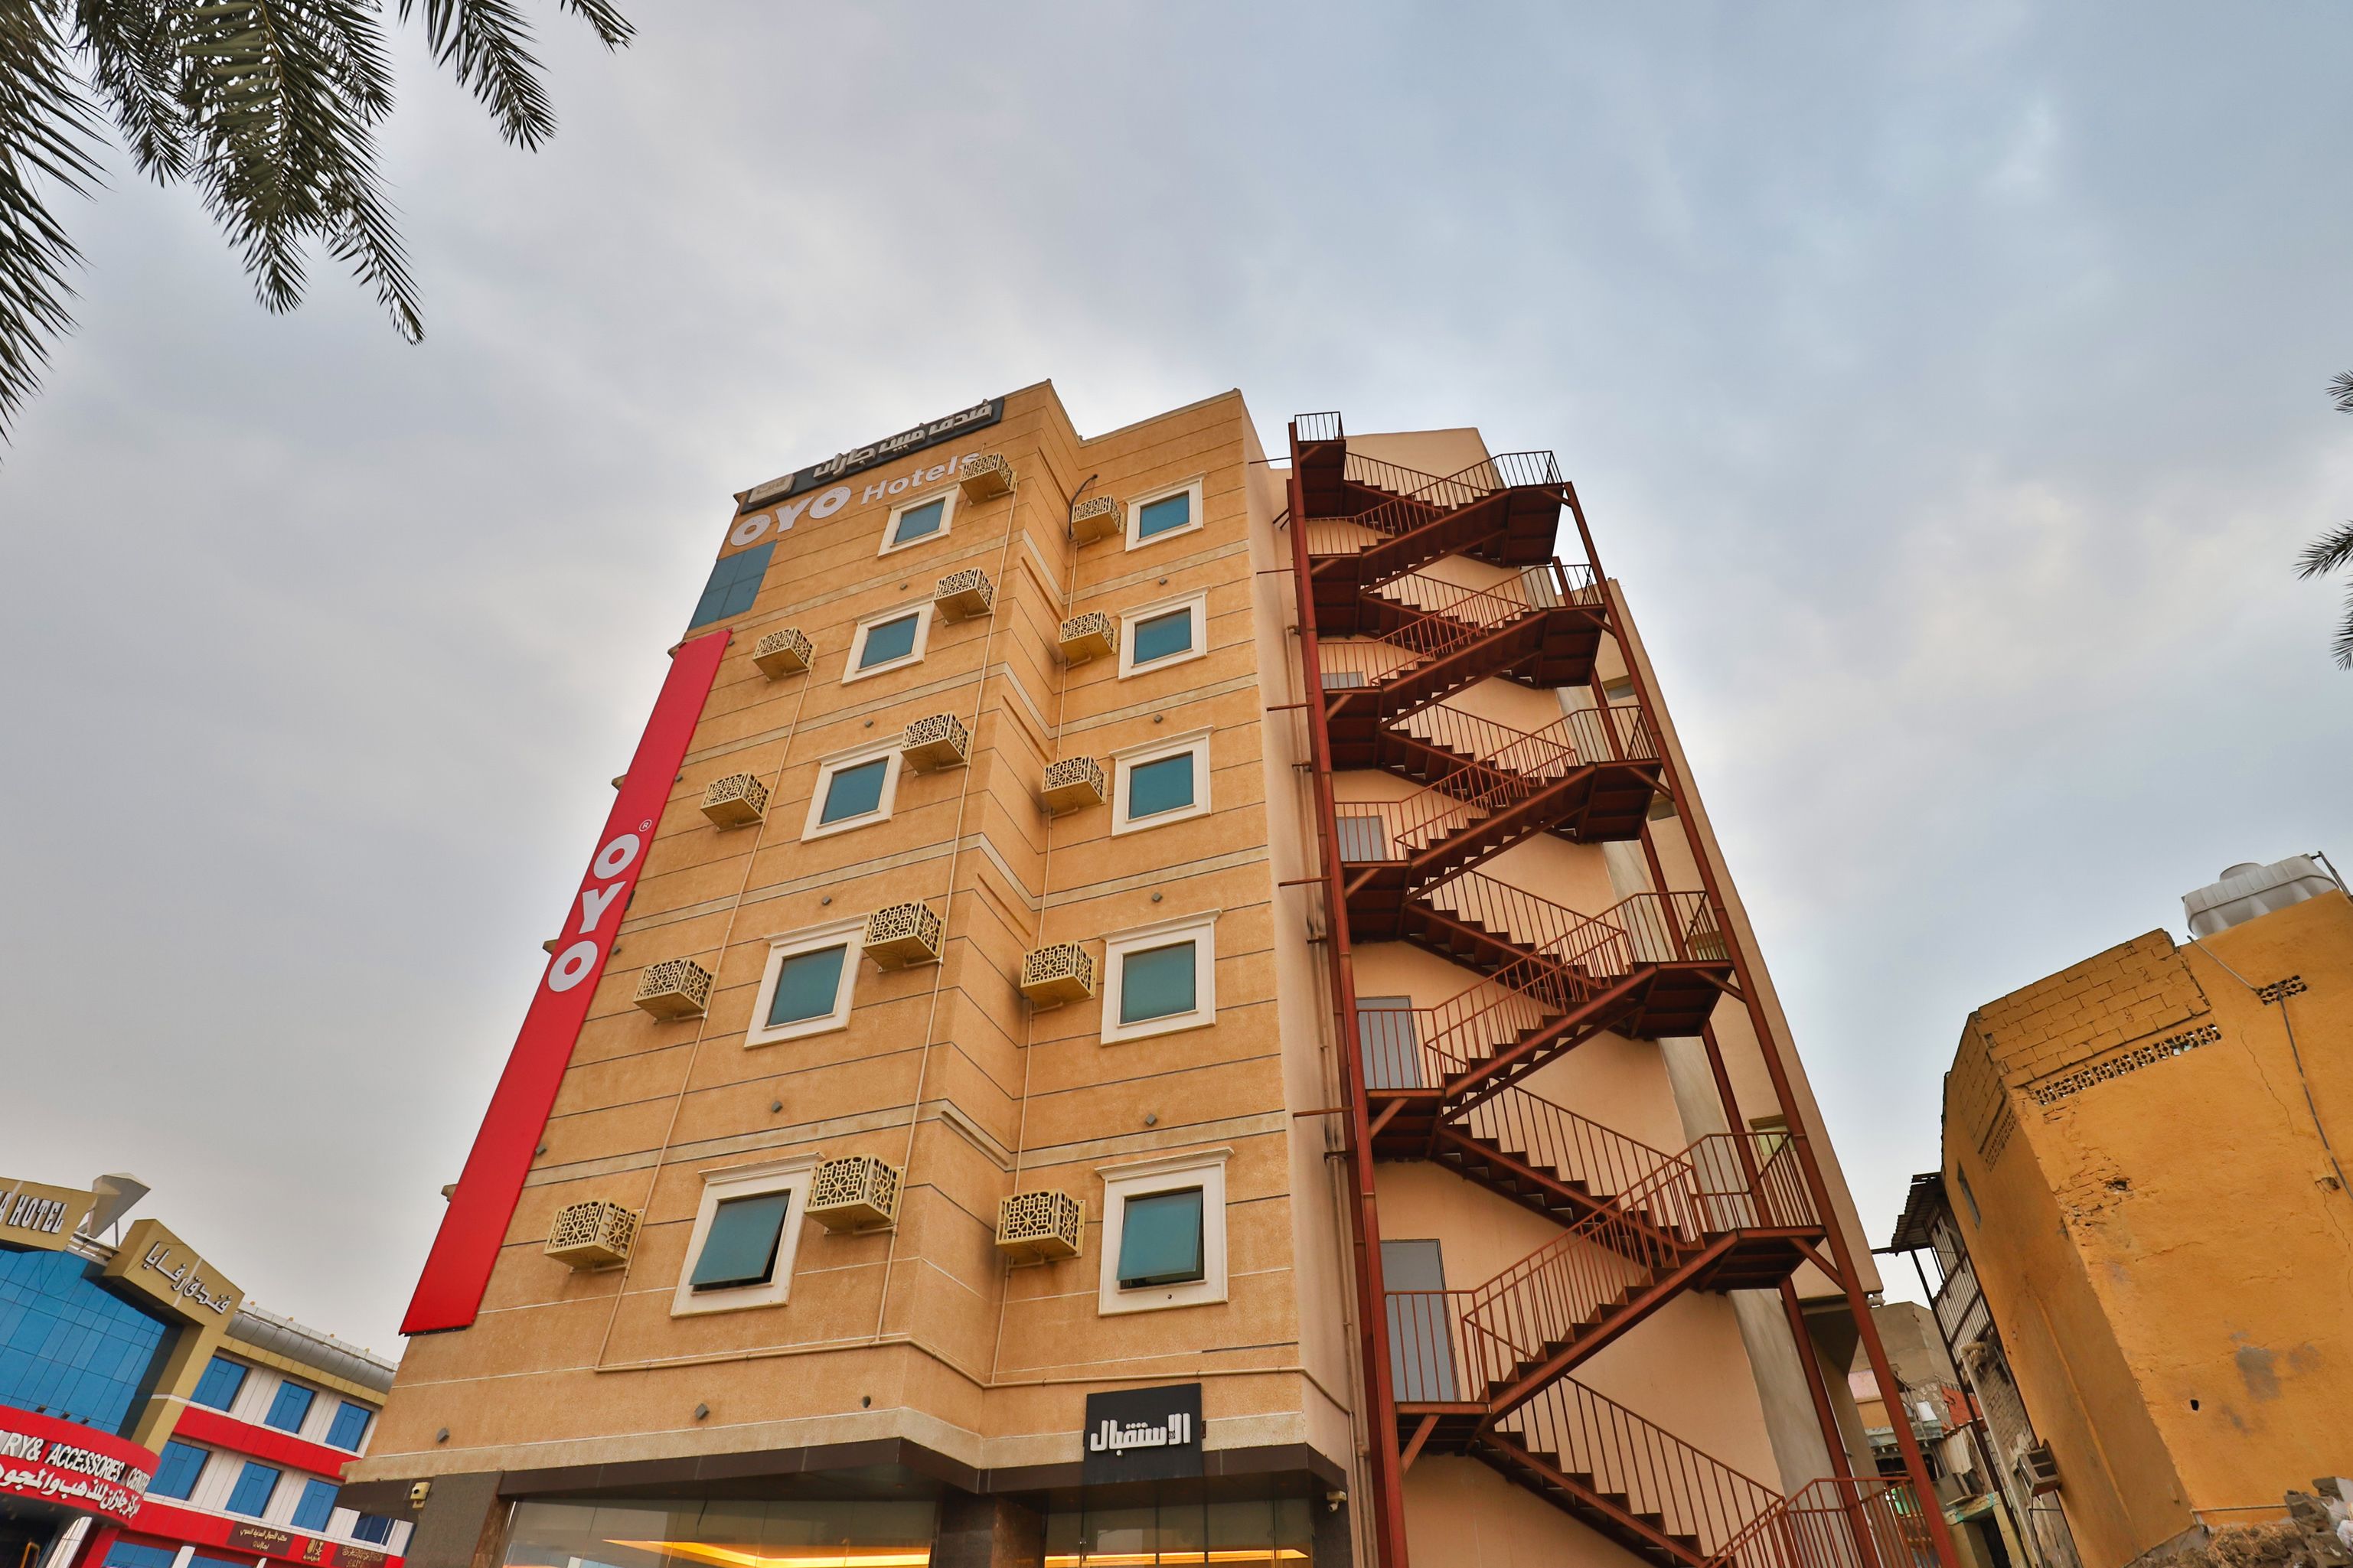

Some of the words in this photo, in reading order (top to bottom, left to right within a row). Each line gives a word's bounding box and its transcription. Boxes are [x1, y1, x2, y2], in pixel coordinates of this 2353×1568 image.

[929, 399, 993, 435] فندق
[813, 448, 876, 478] جازان
[730, 487, 851, 546] OYO
[548, 833, 640, 993] OYO
[7, 1195, 68, 1233] HOTEL
[142, 1241, 188, 1292] رفايا
[183, 1276, 231, 1315] فندق
[44, 1443, 125, 1482] ACCESSORIES
